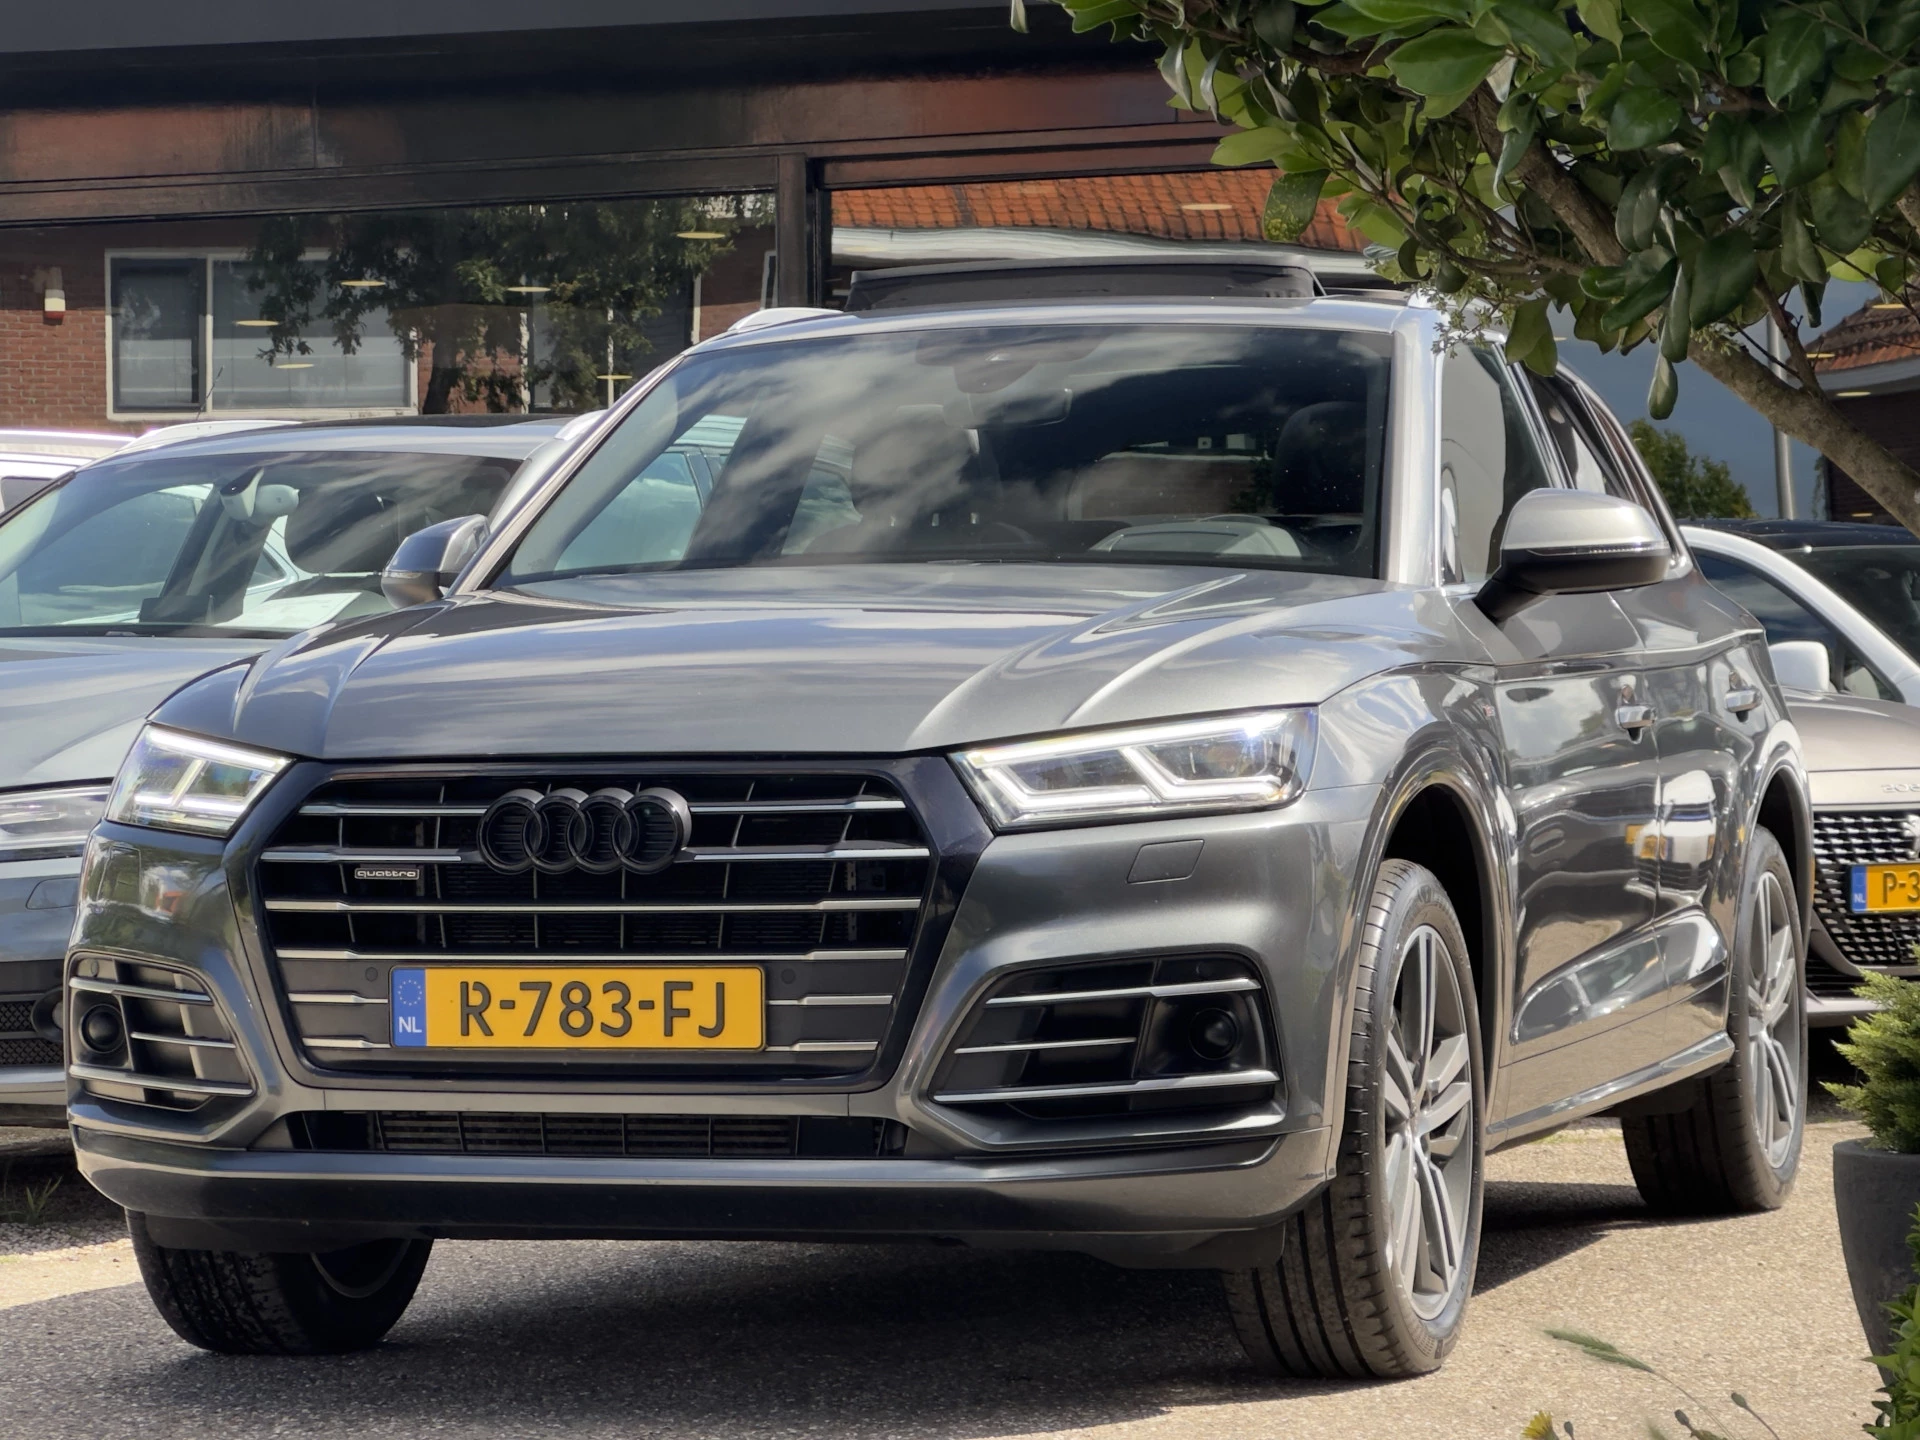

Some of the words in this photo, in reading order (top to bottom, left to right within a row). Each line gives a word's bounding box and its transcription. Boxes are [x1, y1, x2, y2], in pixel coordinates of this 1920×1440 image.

[357, 870, 416, 878] quattro
[1883, 870, 1920, 905] P-3
[1854, 893, 1866, 903] NL
[460, 981, 725, 1038] R-783-FJ
[399, 1017, 422, 1033] NL
